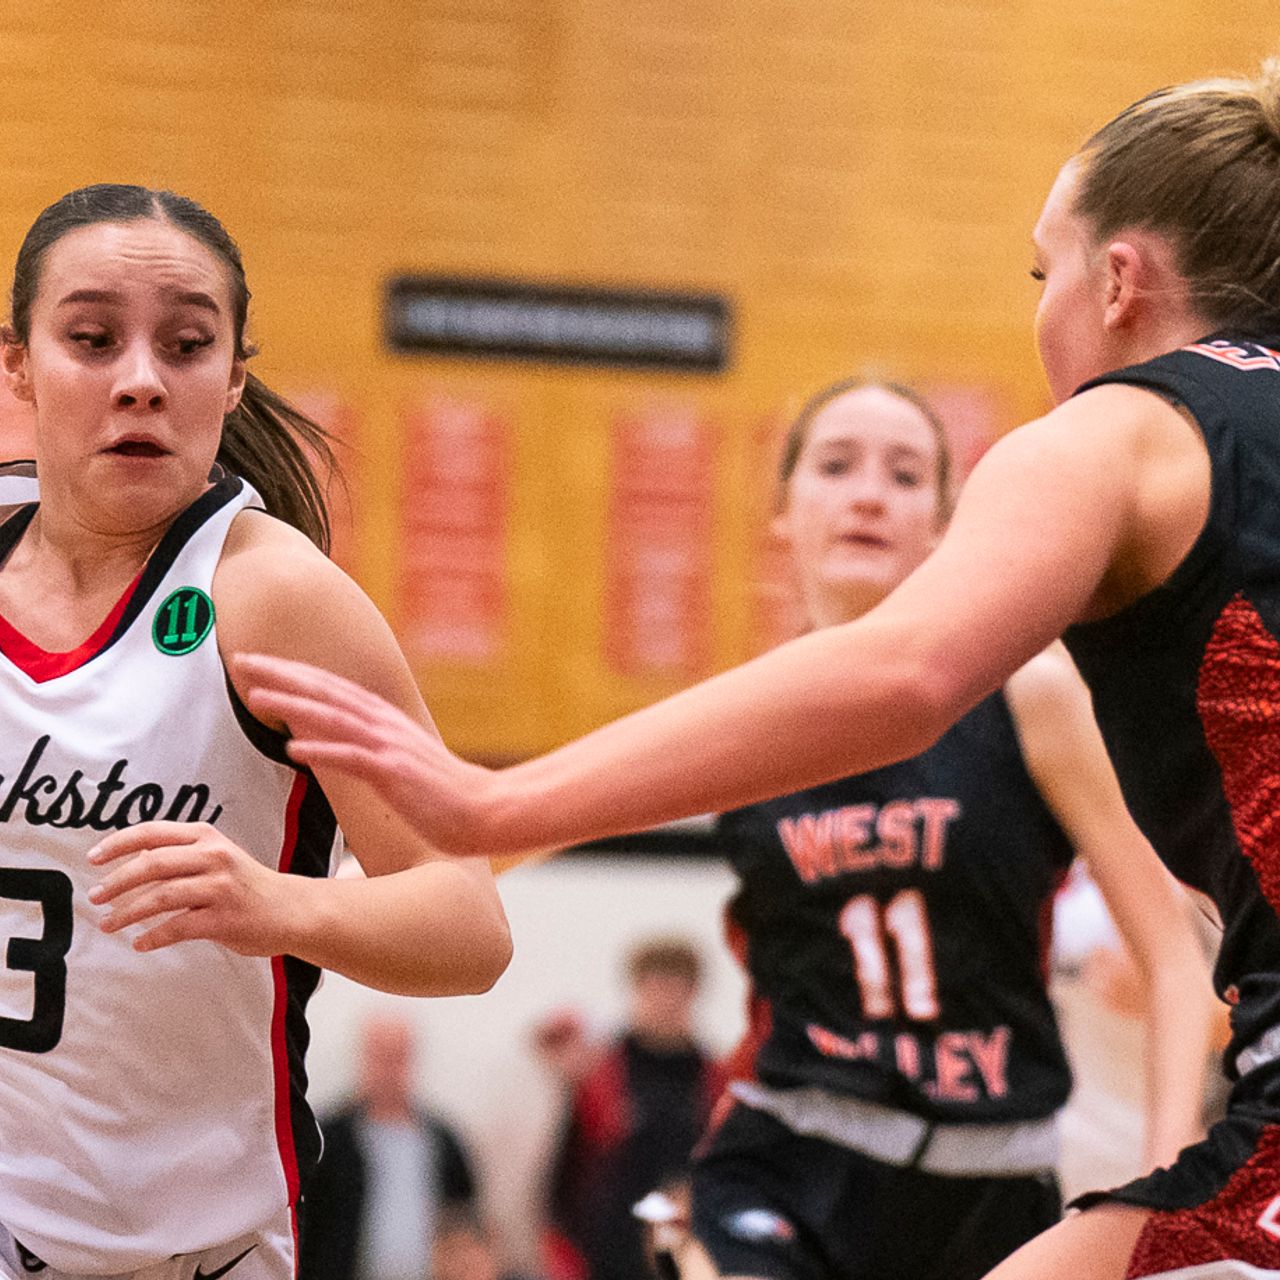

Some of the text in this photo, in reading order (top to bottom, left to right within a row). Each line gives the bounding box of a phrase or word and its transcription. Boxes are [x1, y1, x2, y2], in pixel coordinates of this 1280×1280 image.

[163, 594, 199, 644] 11
[777, 797, 961, 884] WEST
[838, 887, 941, 1021] 11
[805, 1023, 1012, 1102] VEY
